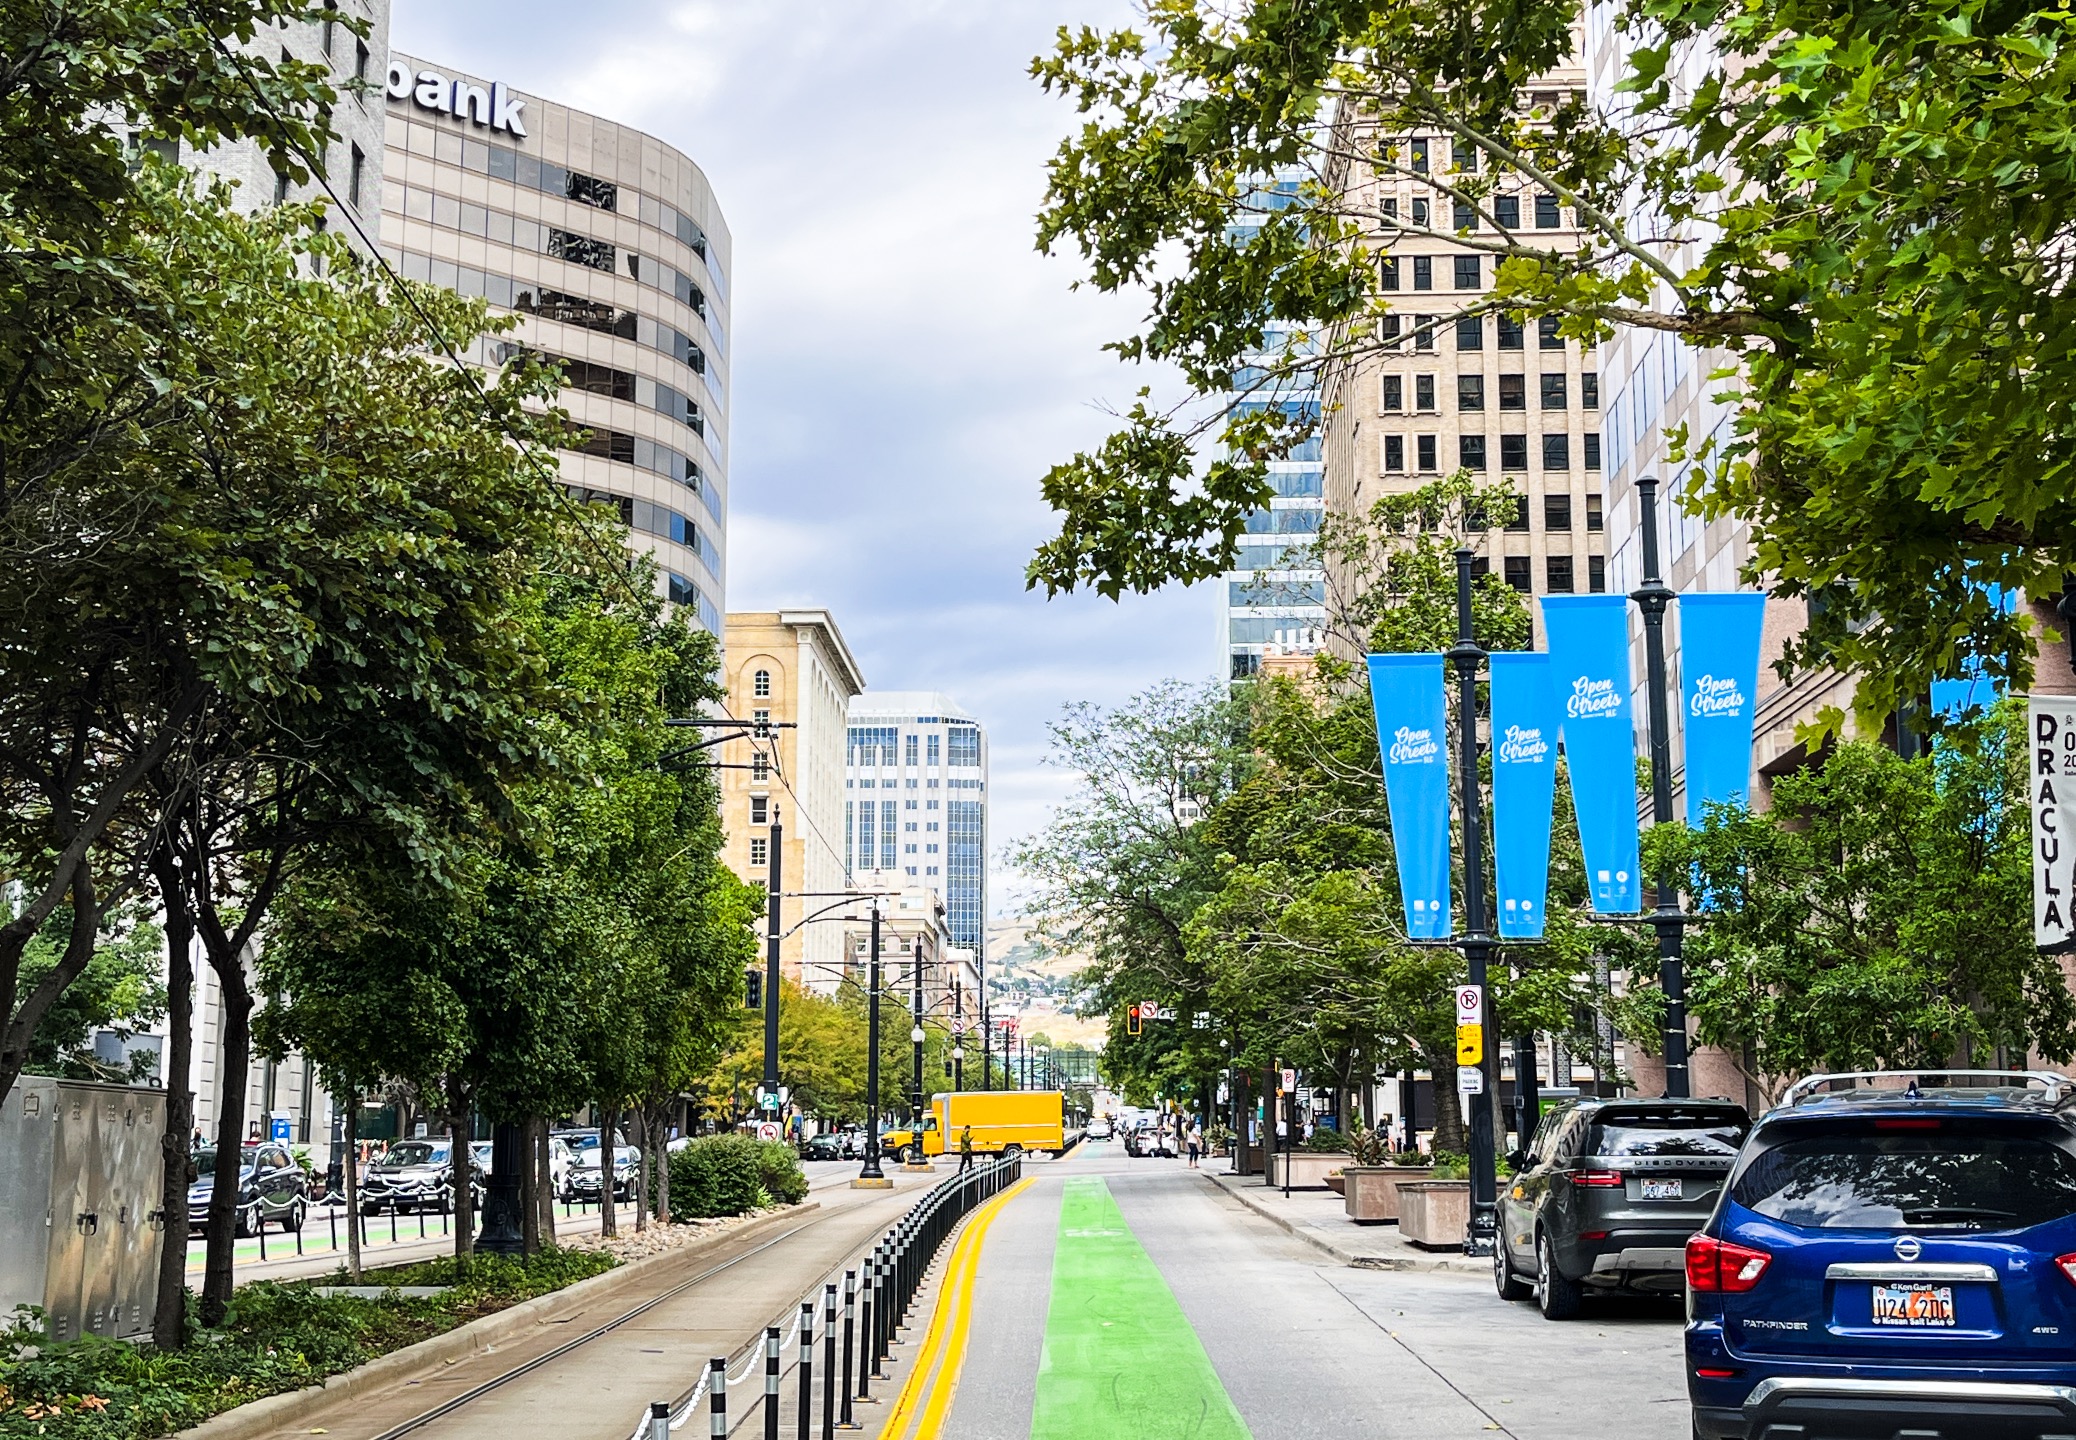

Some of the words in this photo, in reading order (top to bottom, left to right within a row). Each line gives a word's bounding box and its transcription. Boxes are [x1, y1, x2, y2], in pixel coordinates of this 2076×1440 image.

[387, 50, 528, 138] bank
[1572, 675, 1615, 698] Open
[1695, 673, 1738, 697] Open
[1566, 690, 1622, 719] Streets
[1690, 690, 1745, 717] Streets
[1394, 725, 1431, 746] Open
[1504, 724, 1541, 745] Open
[1389, 739, 1438, 764] Streets
[1499, 738, 1548, 763] Streets
[2036, 713, 2065, 931] DRACULA
[763, 1095, 775, 1109] 2
[277, 1127, 286, 1137] P
[1634, 1159, 1729, 1167] DISCOVERY
[1742, 1319, 1809, 1331] PATHFINDER
[1882, 1317, 1909, 1325] Nissan
[1909, 1317, 1926, 1326] Salt
[1926, 1318, 1945, 1326] Lake
[2032, 1326, 2059, 1334] 4WD
